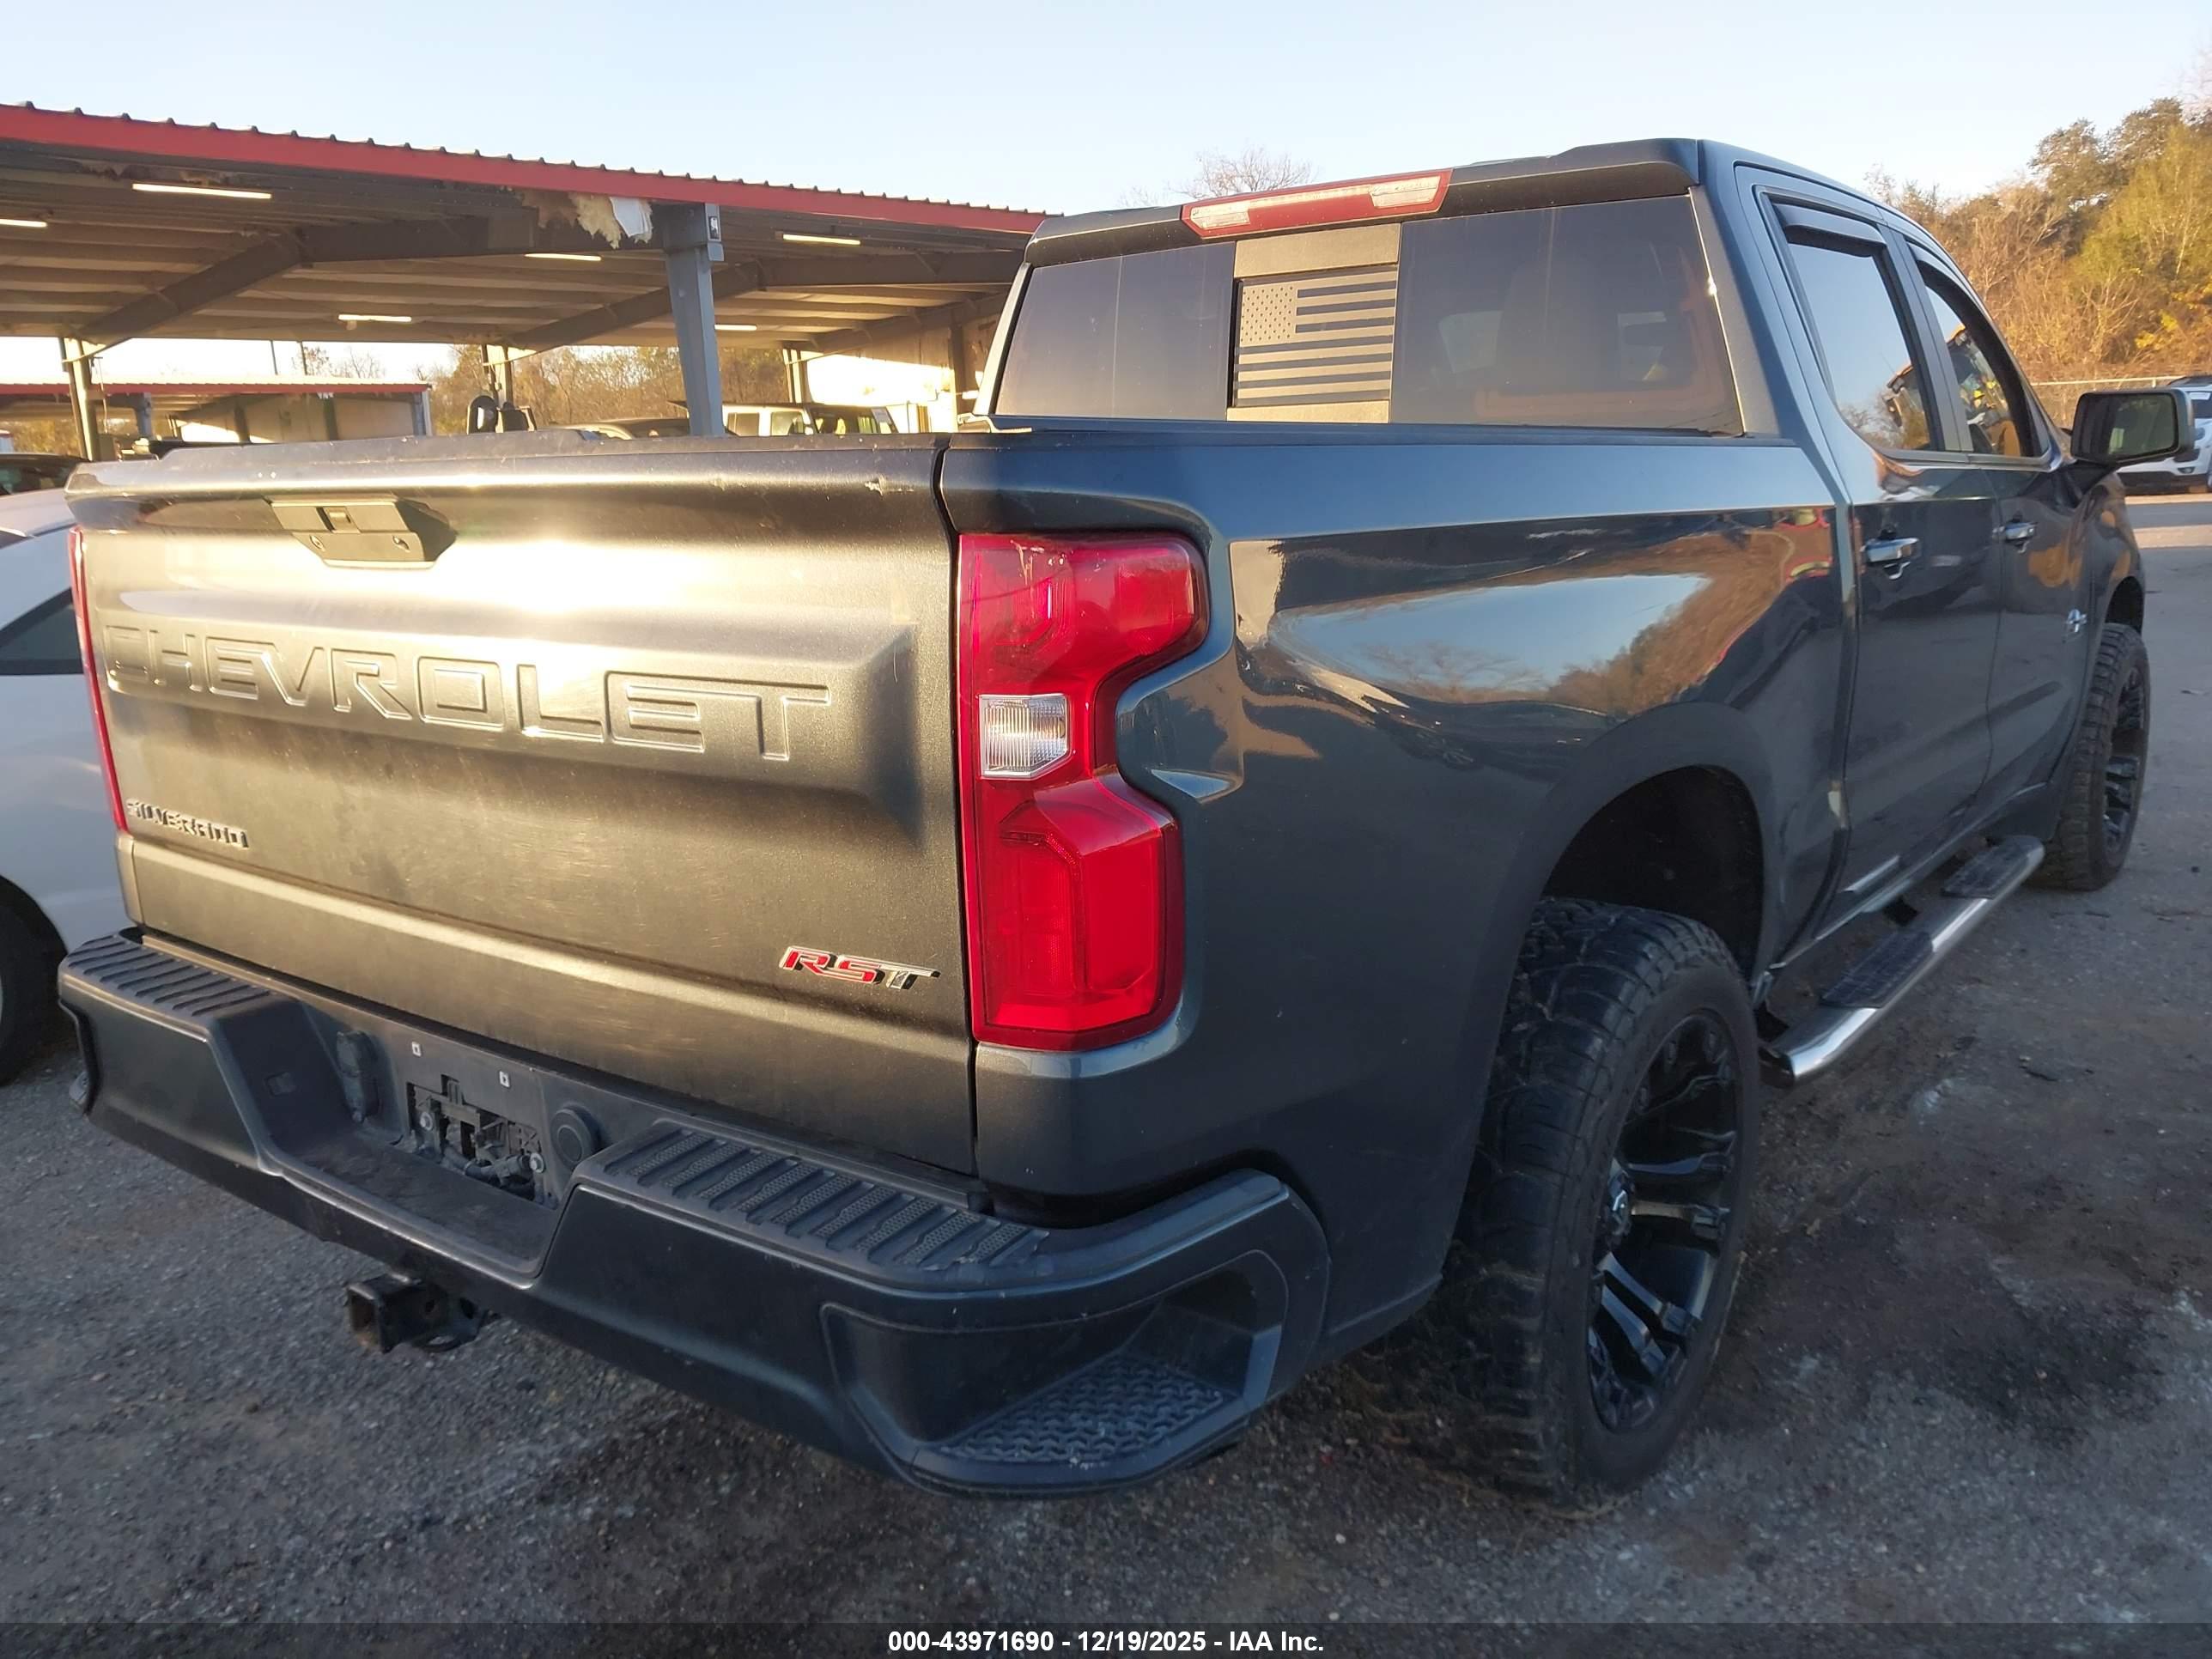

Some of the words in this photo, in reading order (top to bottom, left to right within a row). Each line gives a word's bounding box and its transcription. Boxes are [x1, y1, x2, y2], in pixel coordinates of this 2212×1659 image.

[103, 625, 830, 761] CHEVROLET
[126, 799, 249, 848] SILVERADO
[779, 945, 941, 990] RST
